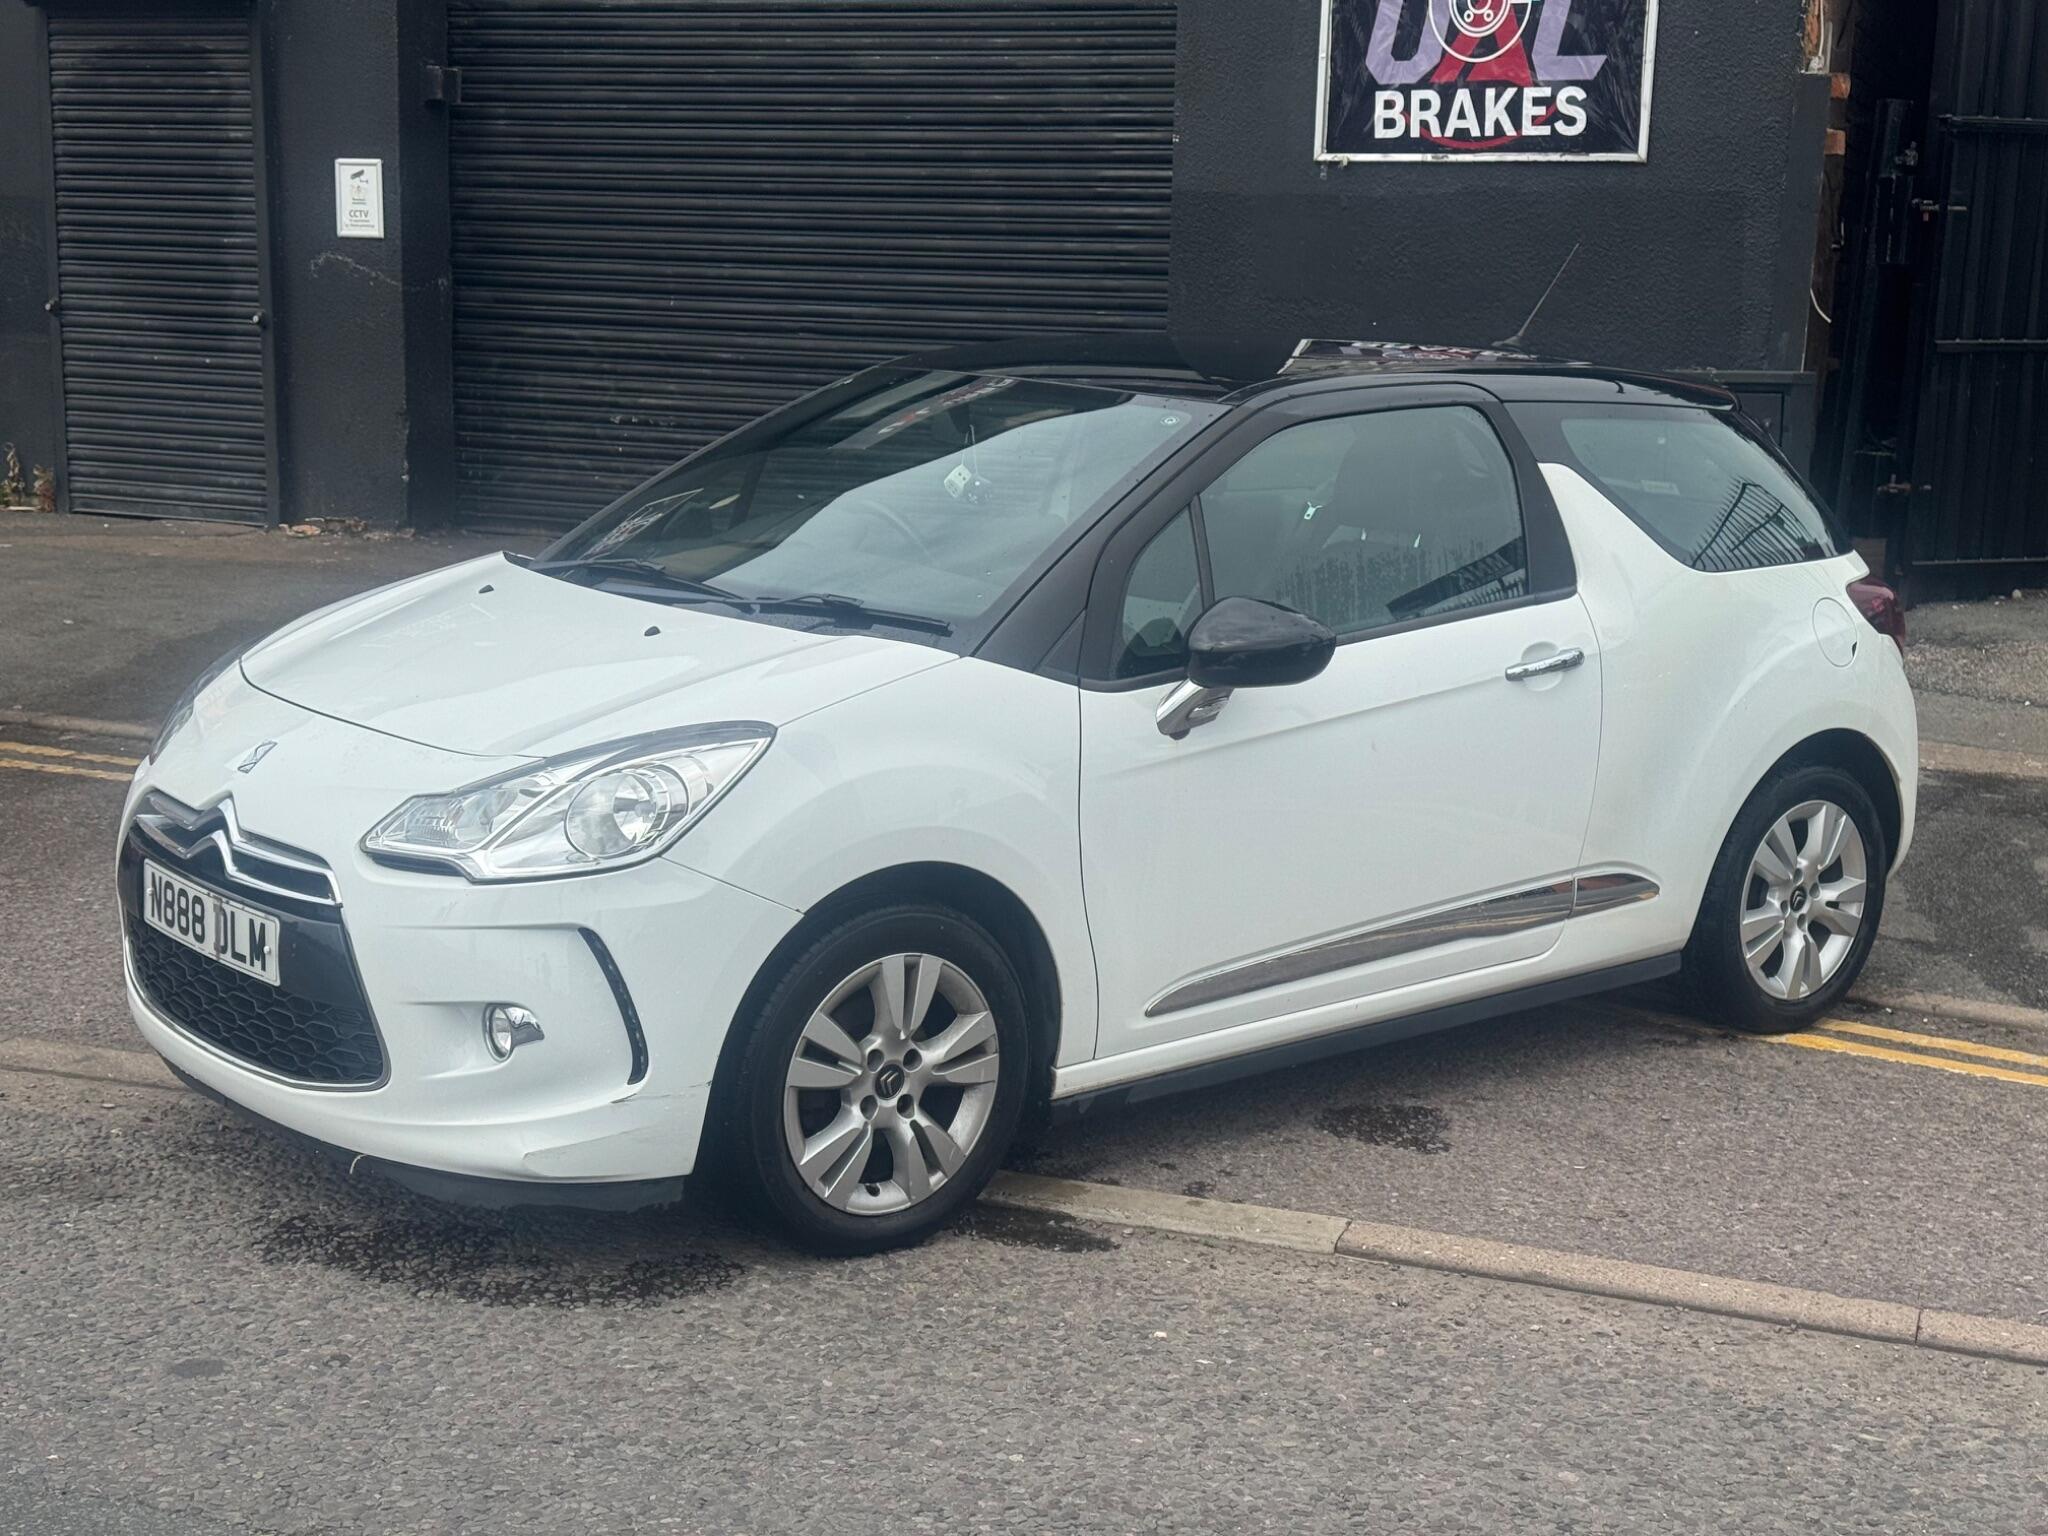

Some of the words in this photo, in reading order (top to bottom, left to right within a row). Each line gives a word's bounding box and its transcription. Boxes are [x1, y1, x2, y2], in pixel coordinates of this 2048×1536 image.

[1373, 86, 1588, 139] BRAKES
[349, 209, 369, 218] CCTV
[151, 871, 206, 945] N888
[213, 903, 267, 972] DLM
